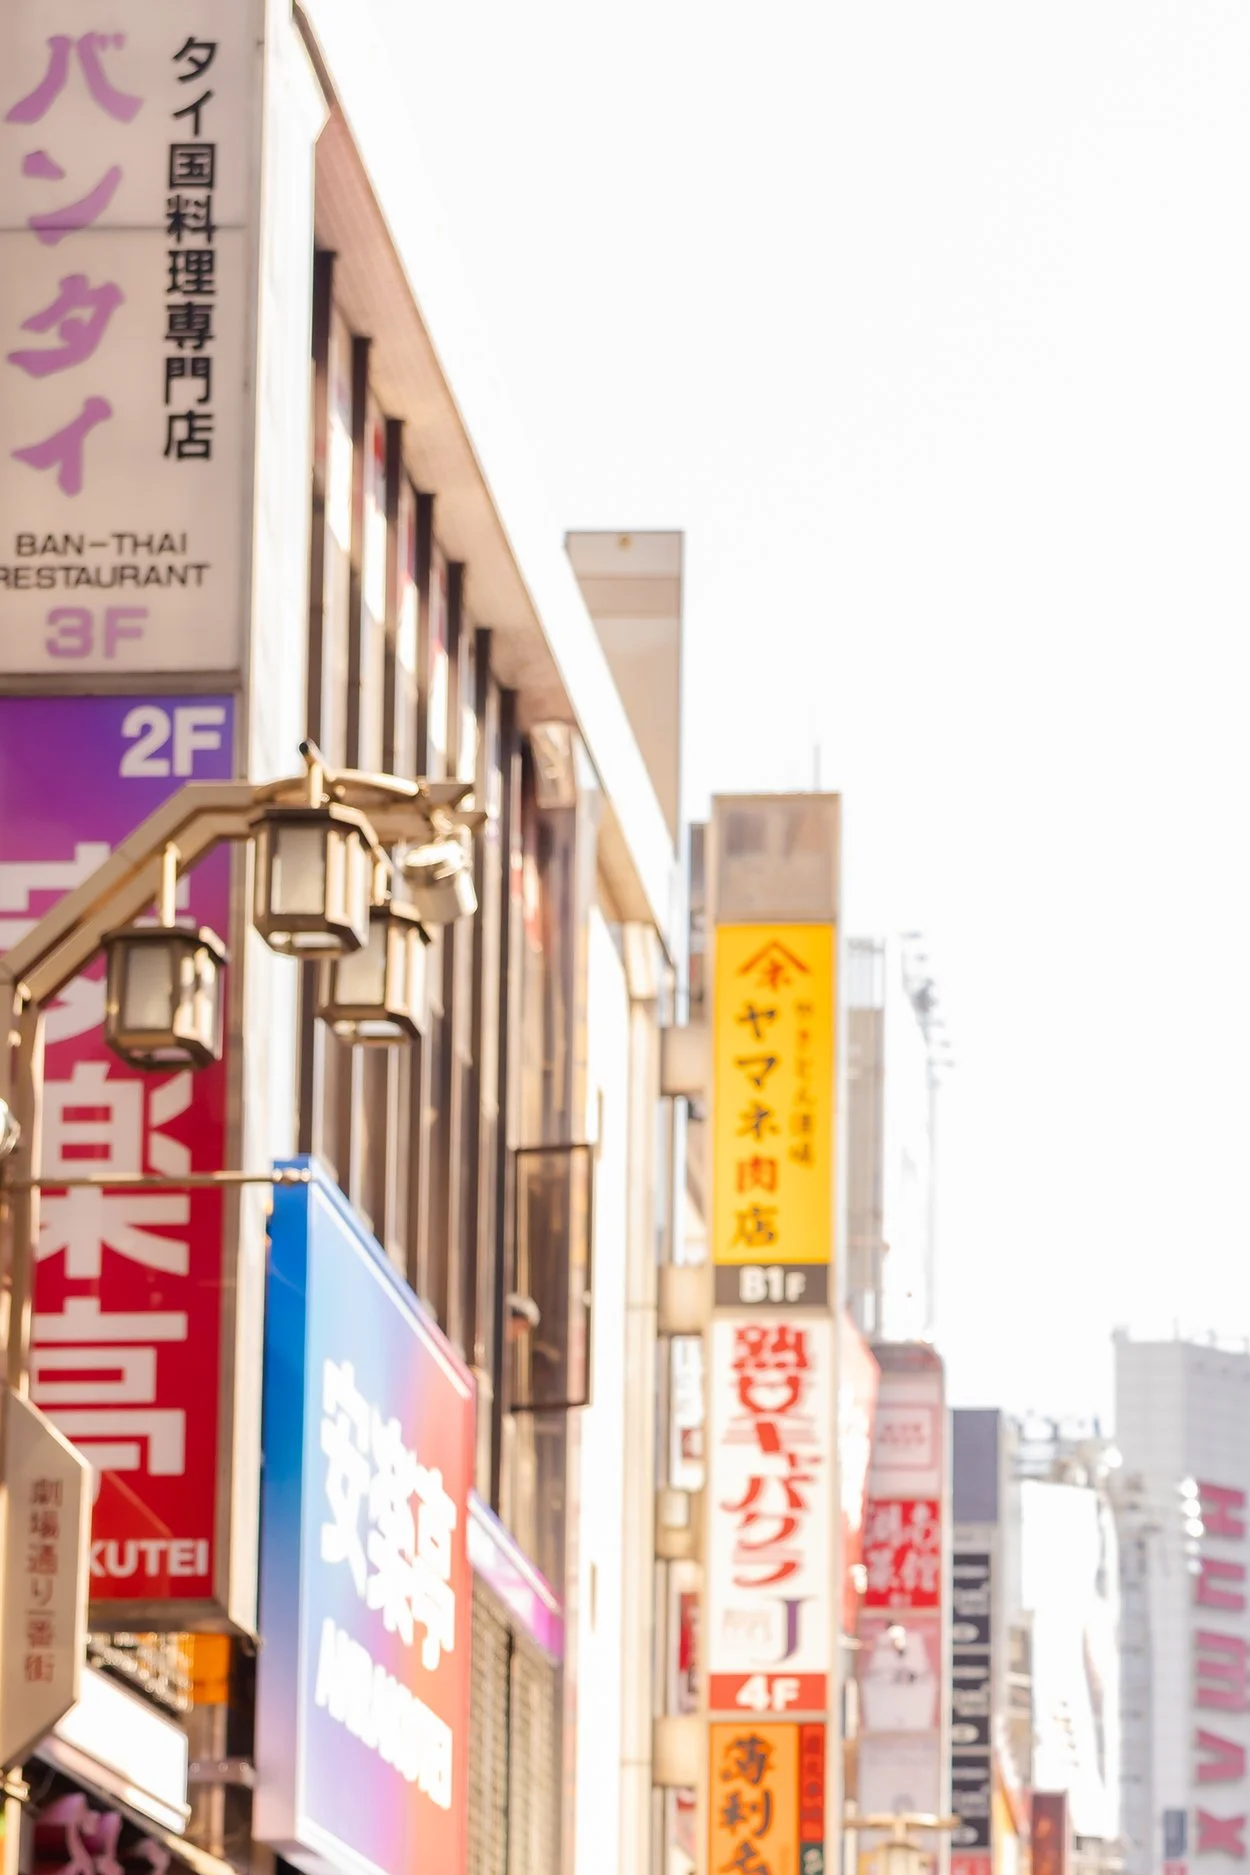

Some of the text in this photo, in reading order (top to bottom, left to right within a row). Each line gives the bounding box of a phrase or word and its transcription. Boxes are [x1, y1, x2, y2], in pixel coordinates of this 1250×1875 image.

[4, 31, 145, 498] バンタイ
[163, 36, 218, 461] タイ国料理専門店
[15, 532, 188, 557] BAN-THAI
[0, 564, 210, 590] RESTAURANT
[45, 606, 149, 659] 3F
[119, 706, 227, 777] 2F
[738, 1265, 806, 1302] B1F
[90, 1539, 209, 1577] KUTEI
[735, 1676, 800, 1710] 4F
